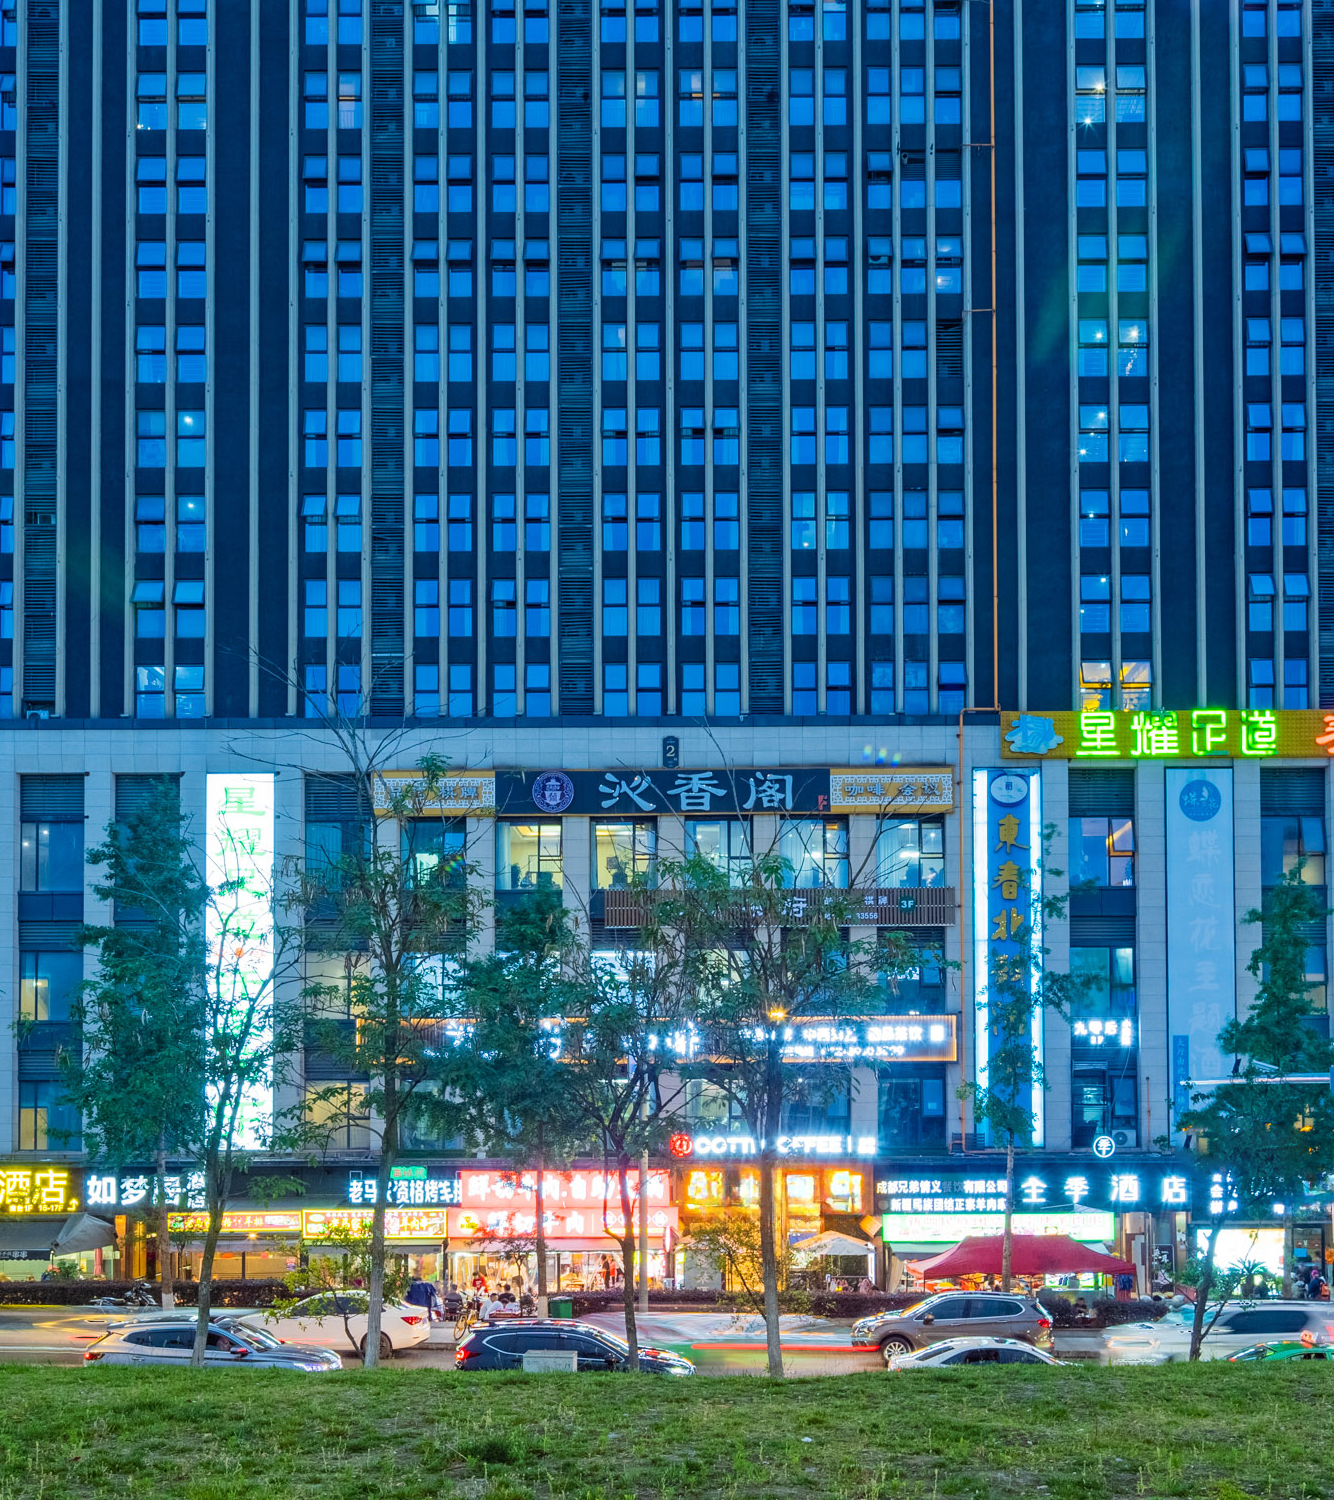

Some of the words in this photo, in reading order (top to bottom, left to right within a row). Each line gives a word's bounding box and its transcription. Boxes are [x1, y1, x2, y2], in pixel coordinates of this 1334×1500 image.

[1076, 710, 1279, 755] 星耀足道
[666, 745, 675, 757] 2
[599, 771, 793, 812] 沁香阁
[845, 781, 886, 796] 咖啡
[898, 782, 941, 796] 会议
[901, 900, 914, 909] 3F
[1021, 1174, 1187, 1203] 全季酒店
